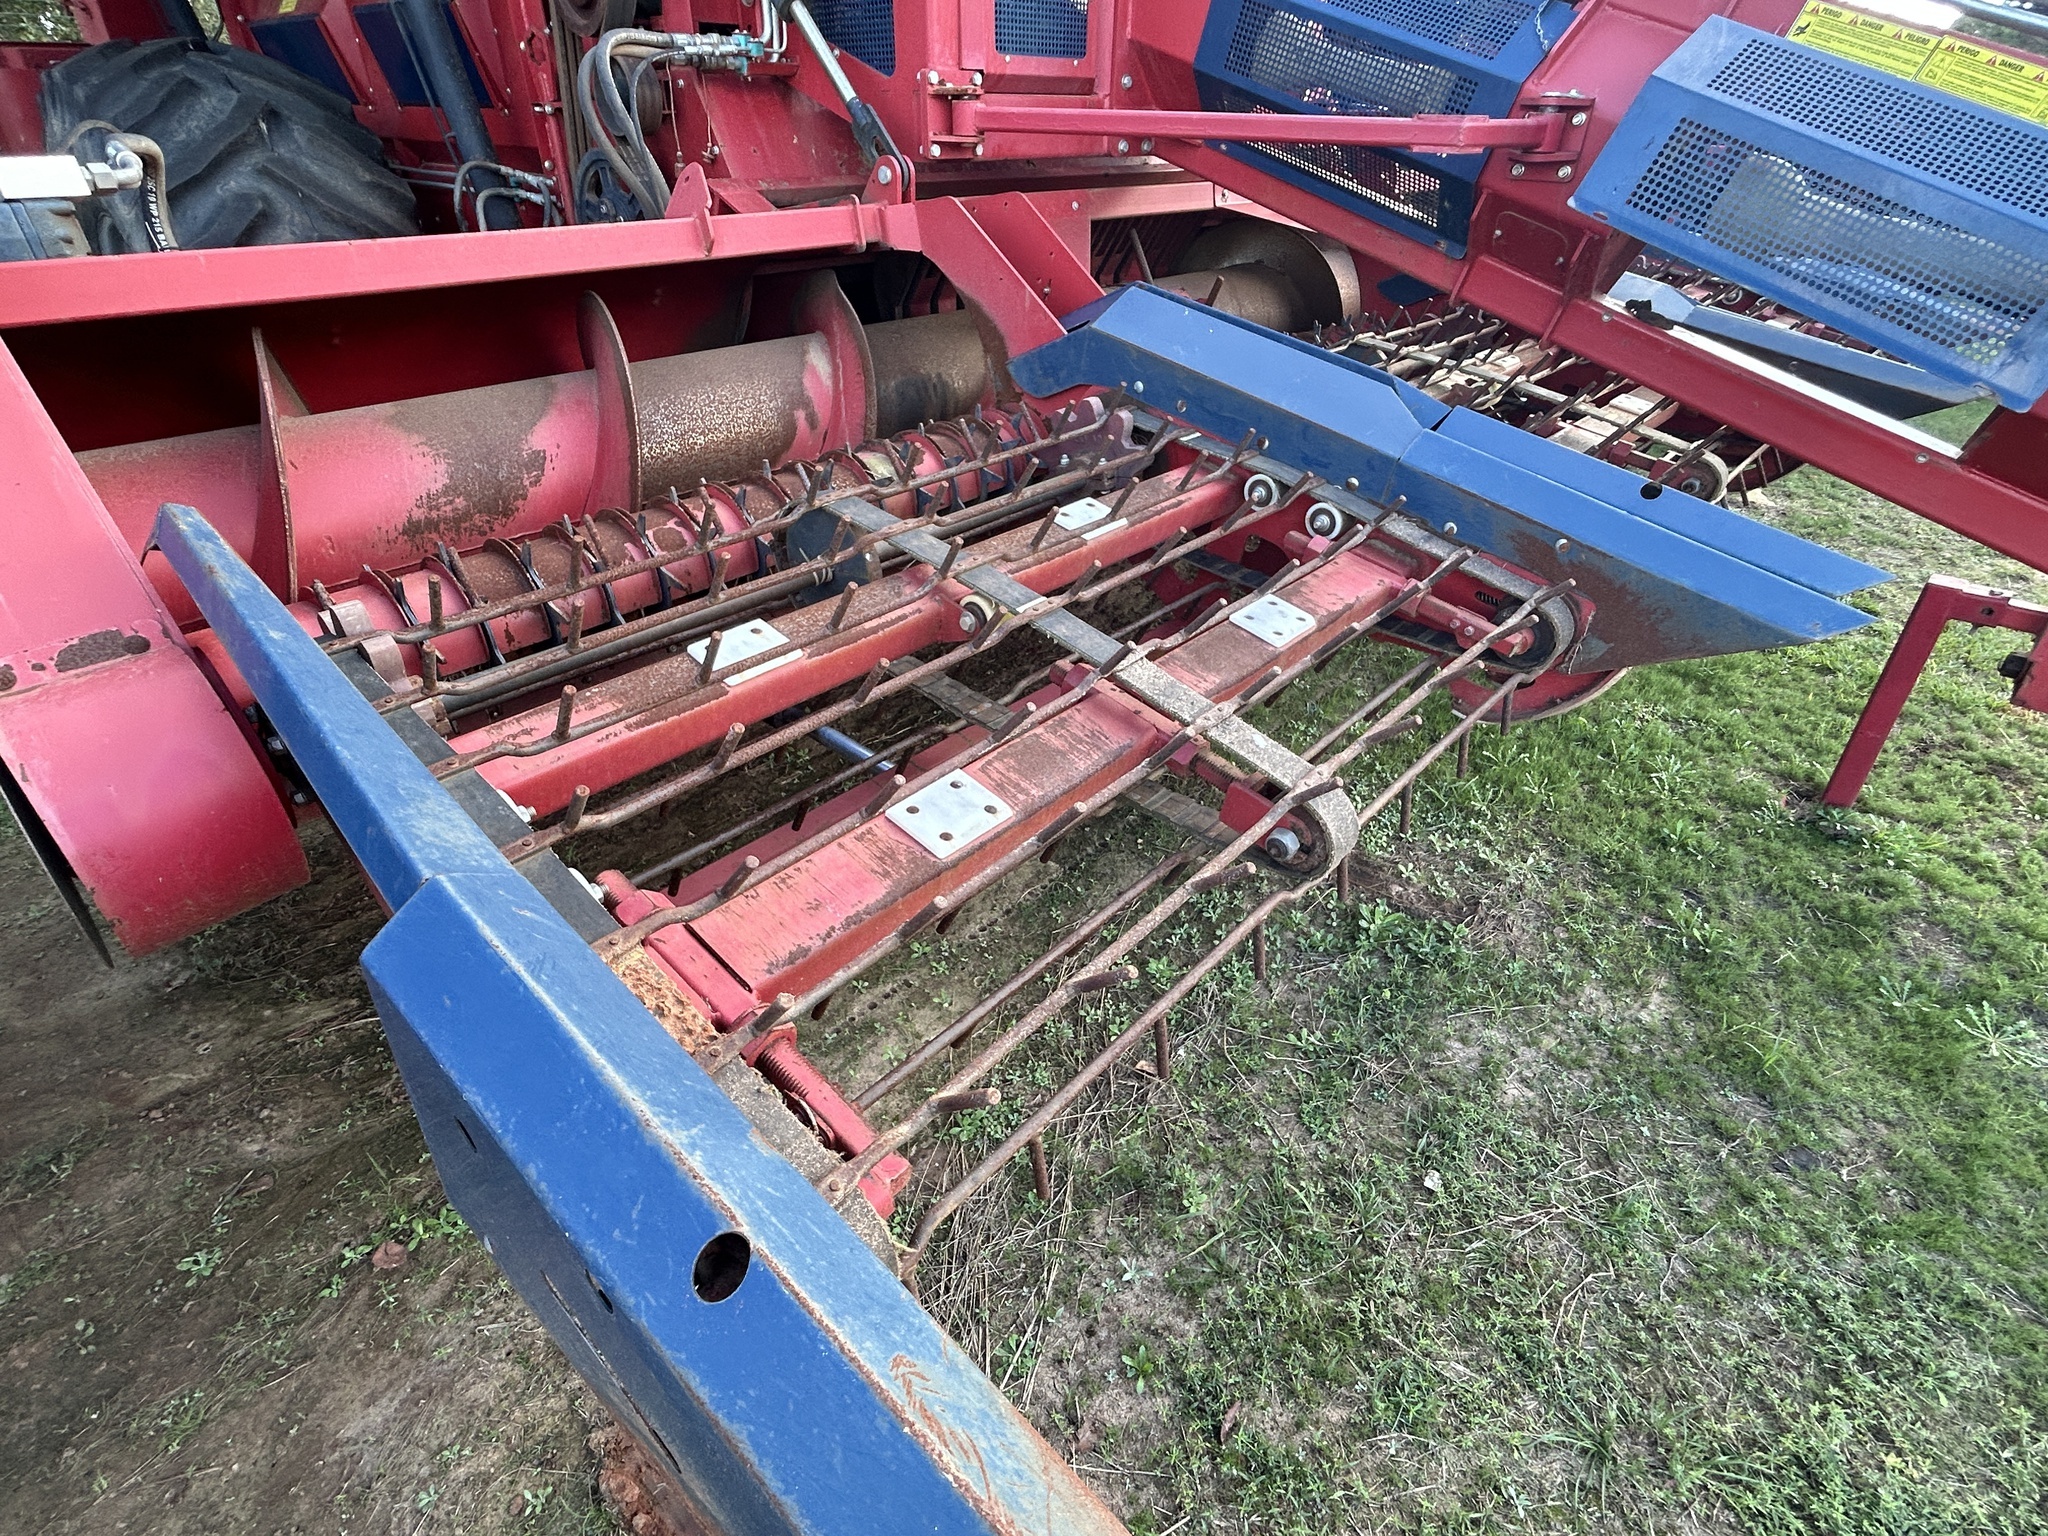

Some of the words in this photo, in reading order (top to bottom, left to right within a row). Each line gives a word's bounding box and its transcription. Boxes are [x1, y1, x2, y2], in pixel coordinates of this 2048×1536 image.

[1820, 6, 1843, 19] PERIGO
[1859, 19, 1884, 32] DANGER
[1904, 32, 1931, 46] PELIGRO
[1957, 45, 1981, 58] PERIGO
[1998, 59, 2025, 73] DANGER
[149, 203, 159, 217] WP
